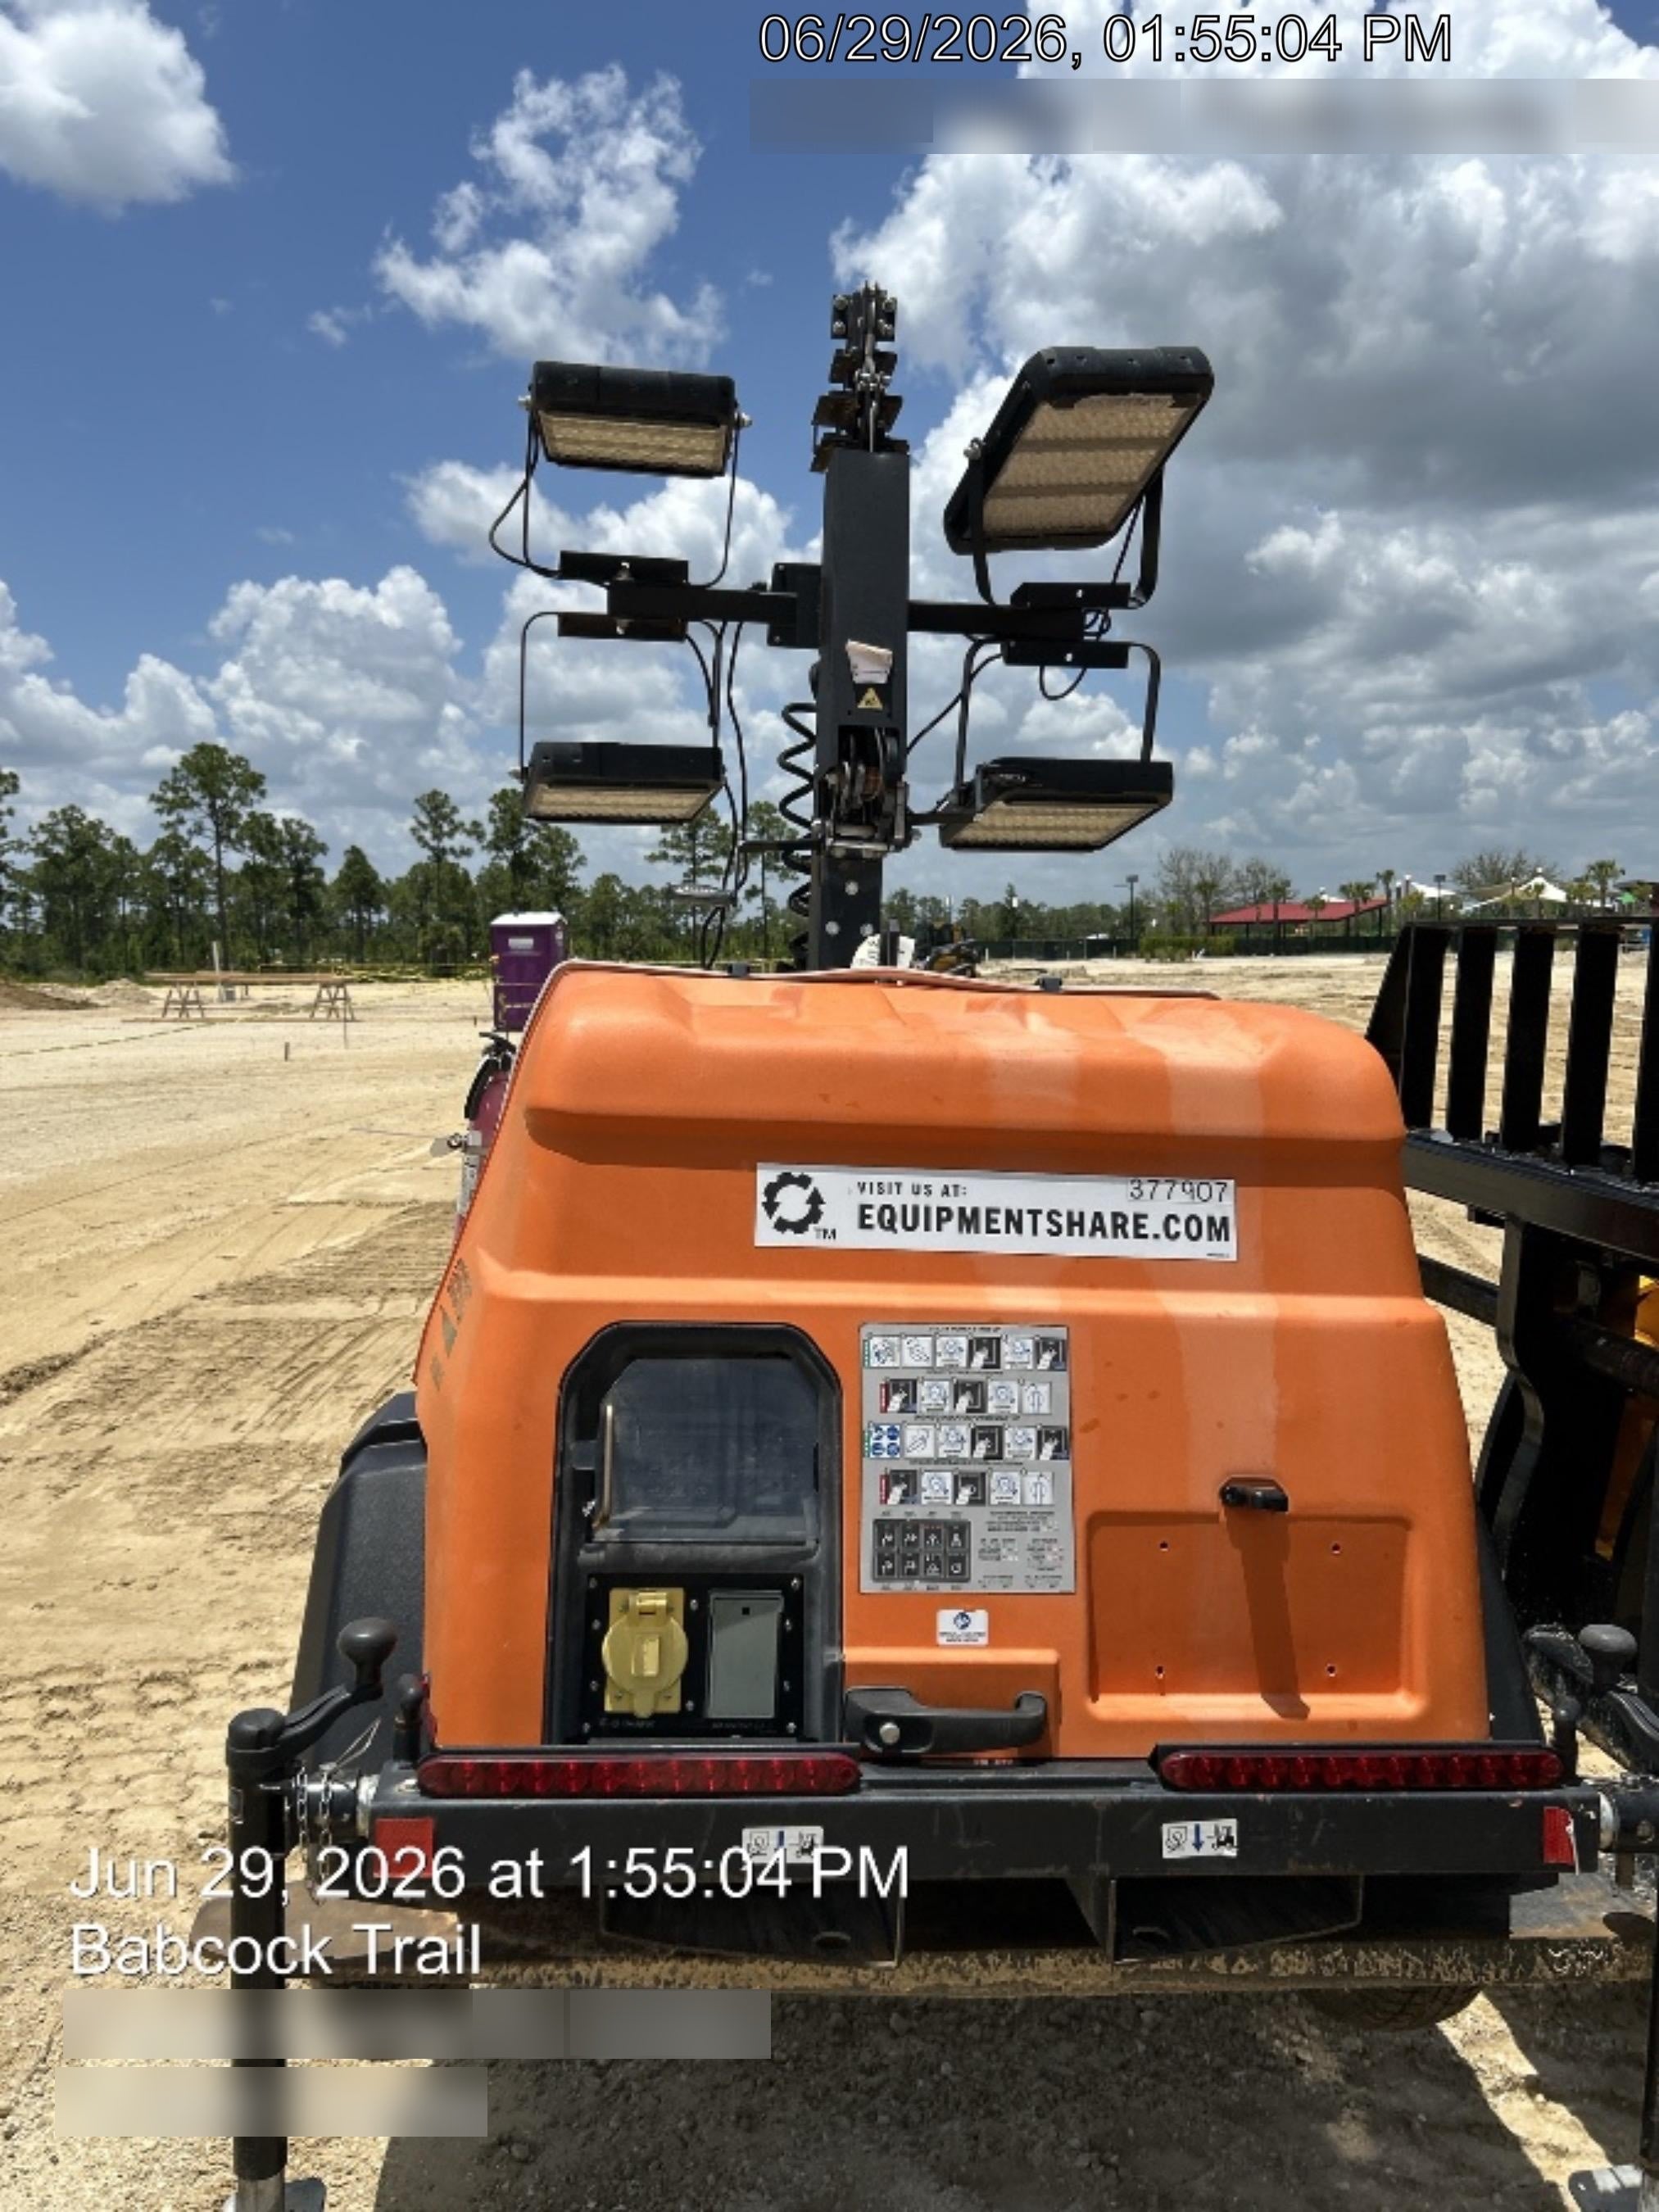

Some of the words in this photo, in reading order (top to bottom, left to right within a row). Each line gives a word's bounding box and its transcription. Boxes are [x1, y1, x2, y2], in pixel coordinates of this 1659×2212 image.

[857, 1181, 903, 1196] VISIT
[912, 1183, 932, 1197] US
[941, 1184, 968, 1199] AT:
[1129, 1179, 1229, 1203] 377907
[858, 1203, 1230, 1242] EQUIPMENTSHARE.COM
